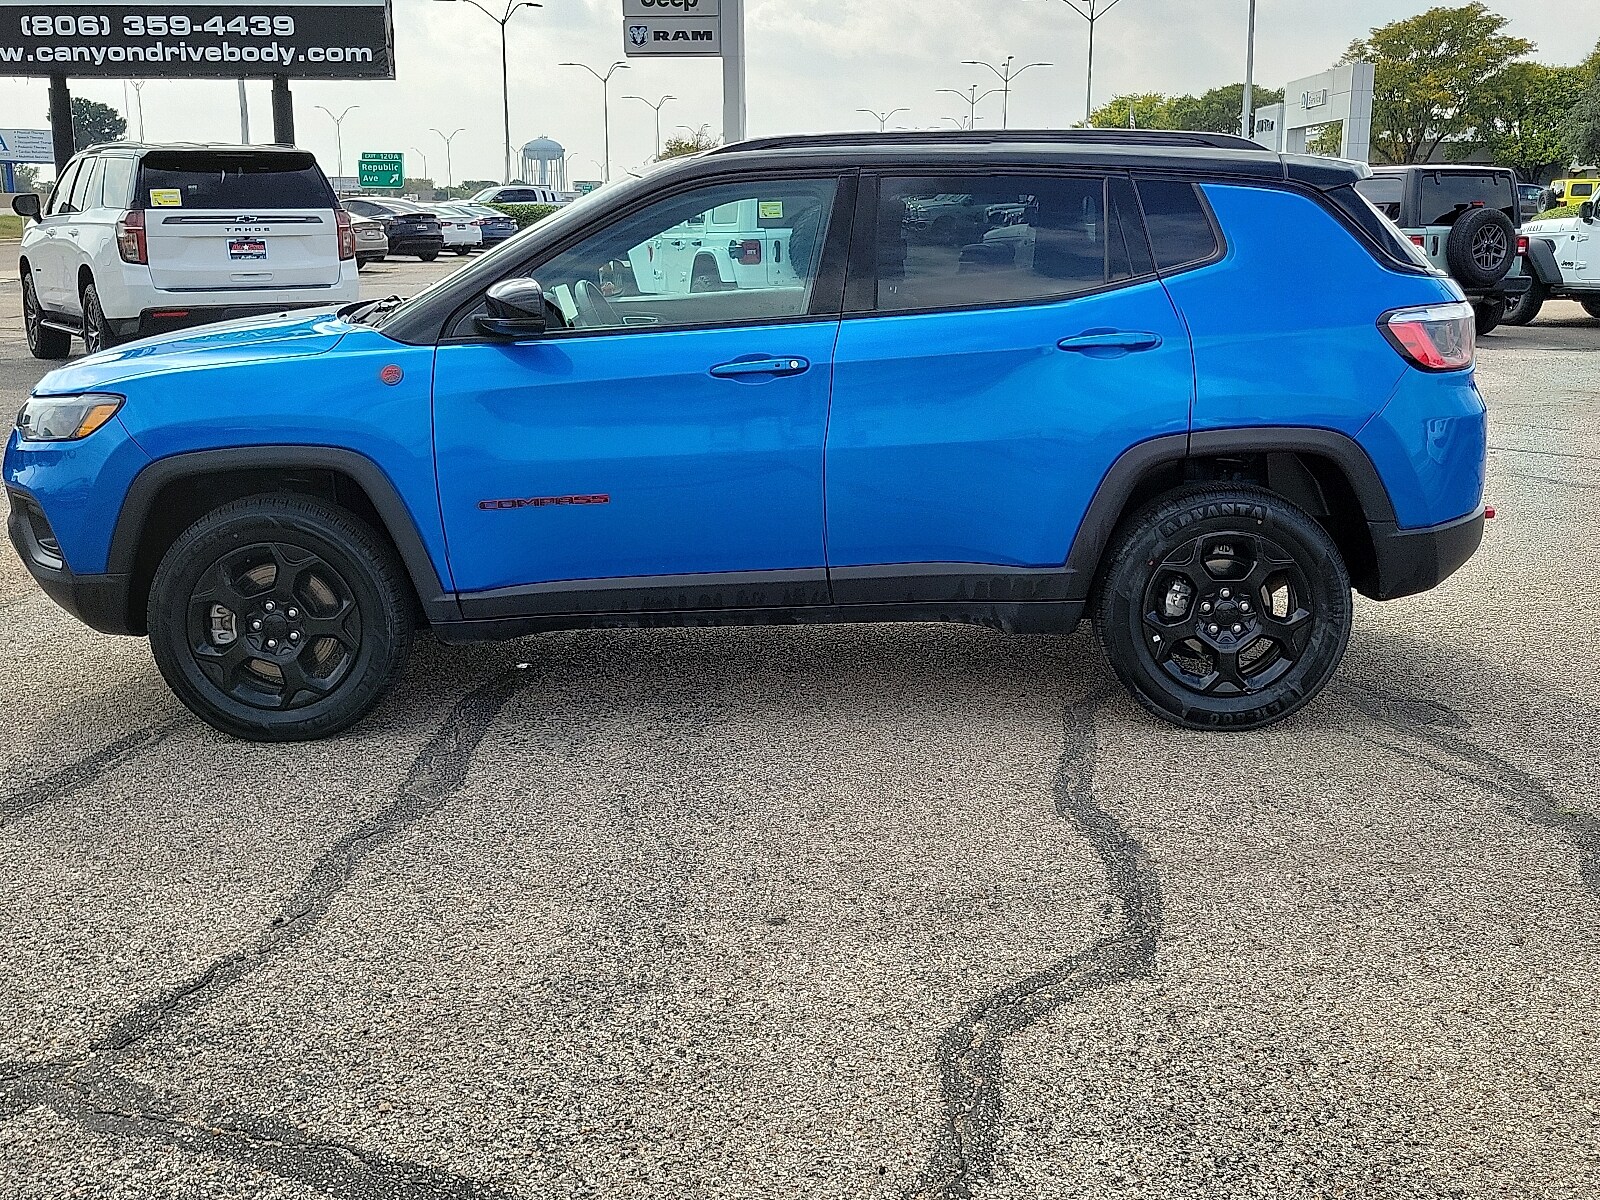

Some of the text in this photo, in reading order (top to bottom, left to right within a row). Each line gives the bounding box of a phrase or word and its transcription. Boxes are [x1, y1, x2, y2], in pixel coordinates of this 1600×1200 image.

[20, 15, 295, 36] (806) 359-4439
[653, 30, 713, 41] RAM
[0, 42, 373, 65] w.canyondrivebody.com
[361, 163, 399, 172] Republic
[362, 174, 379, 182] Ave
[478, 493, 610, 511] COMPASS
